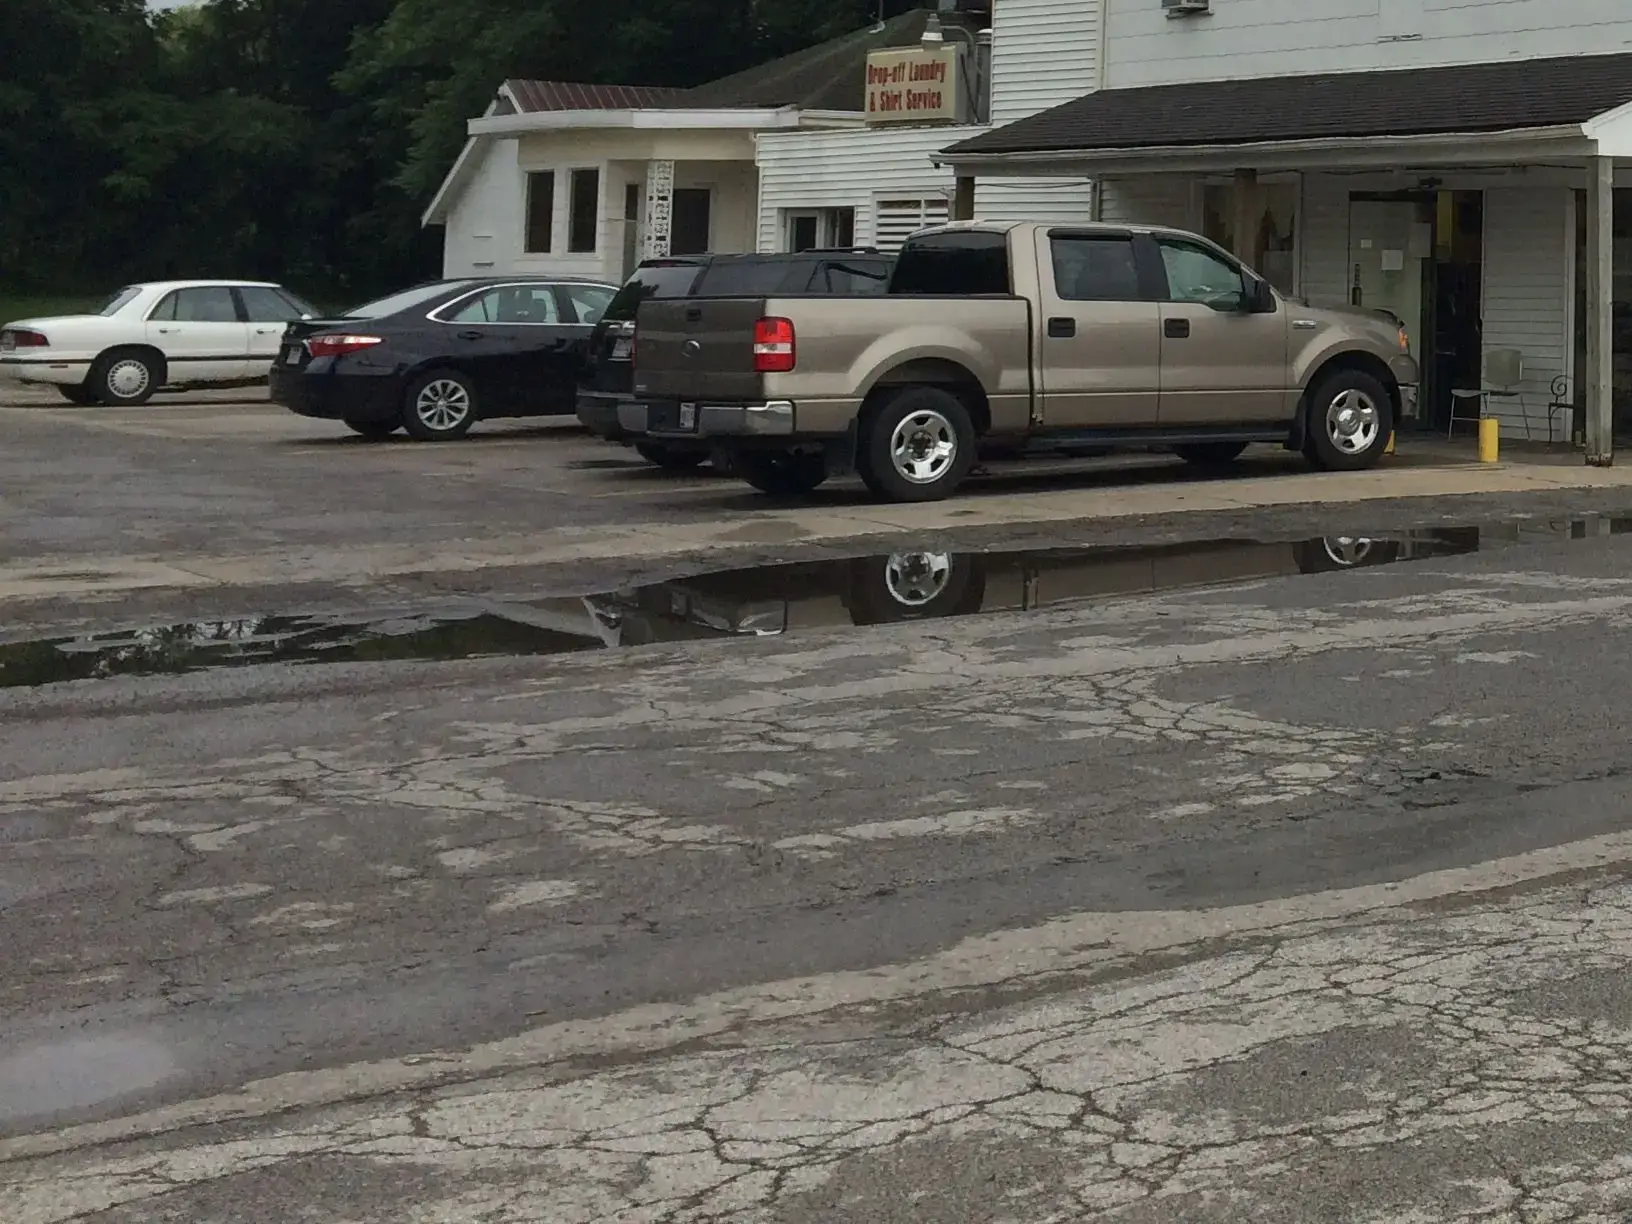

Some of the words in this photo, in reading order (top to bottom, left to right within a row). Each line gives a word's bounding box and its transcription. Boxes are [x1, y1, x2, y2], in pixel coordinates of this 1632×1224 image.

[867, 61, 906, 86] Drop-off
[908, 59, 947, 83] Laundry
[869, 91, 876, 112] &
[880, 89, 902, 111] Shirt
[906, 88, 942, 111] Service
